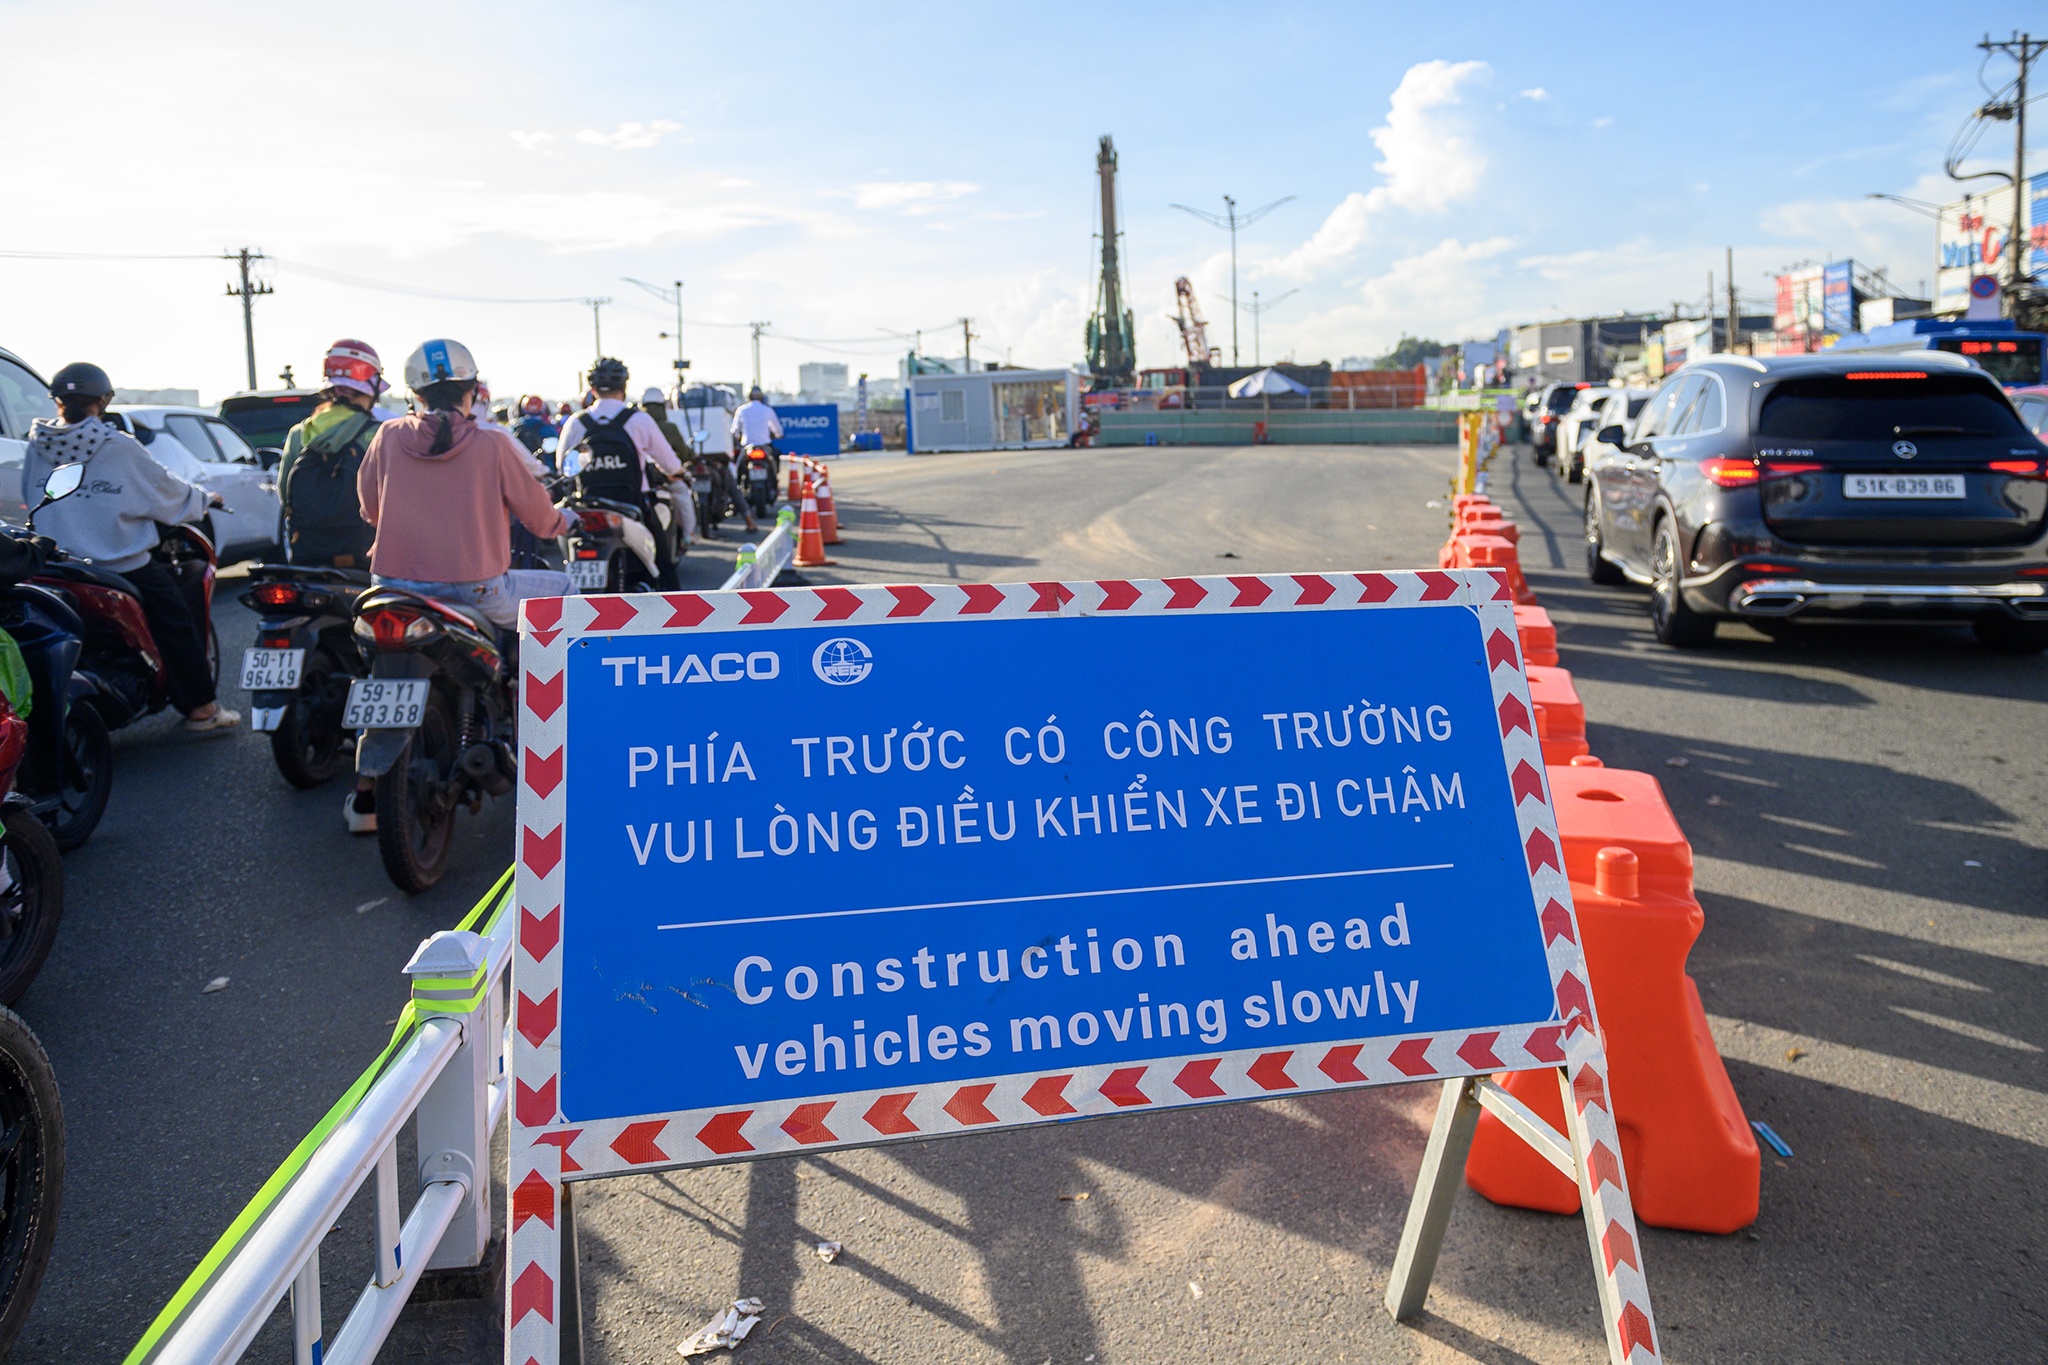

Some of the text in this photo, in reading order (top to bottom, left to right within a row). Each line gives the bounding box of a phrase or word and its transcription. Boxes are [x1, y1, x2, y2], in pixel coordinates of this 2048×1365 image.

[780, 416, 830, 429] THACO
[252, 652, 294, 669] 50-Y1
[602, 651, 780, 686] THACO
[245, 669, 296, 687] 964.49
[361, 683, 414, 702] 59-Y1
[349, 704, 419, 724] 583.68
[630, 699, 1452, 787] PHÍA TRƯỚC CÓ CÔNG TRƯỜNG
[626, 765, 1466, 866] VUI LÒNG ĐIỀU KHIỂN XE ĐI CHẬM
[734, 902, 1411, 1005] Construction ahead
[735, 971, 1419, 1080] vehicles moving slowly
